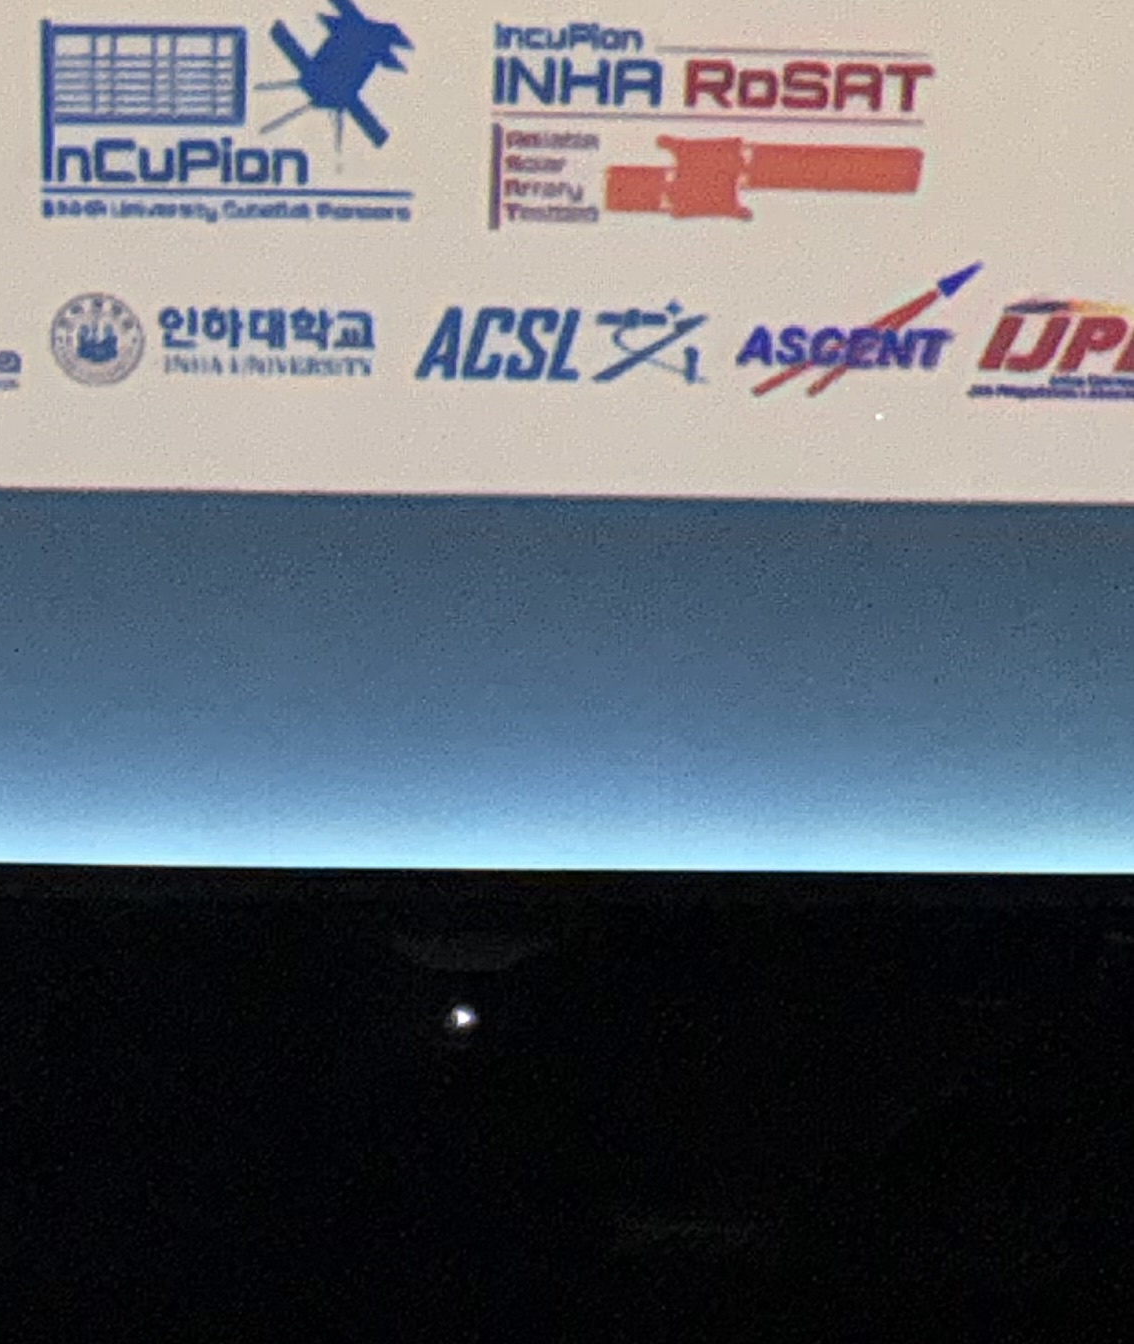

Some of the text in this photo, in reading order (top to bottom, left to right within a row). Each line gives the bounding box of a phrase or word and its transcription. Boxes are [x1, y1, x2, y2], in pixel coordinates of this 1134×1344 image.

[493, 56, 934, 112] INHA RoSAT
[158, 307, 375, 350] 인하대학교
[415, 307, 580, 381] ACSL
[736, 327, 954, 368] ASCENT
